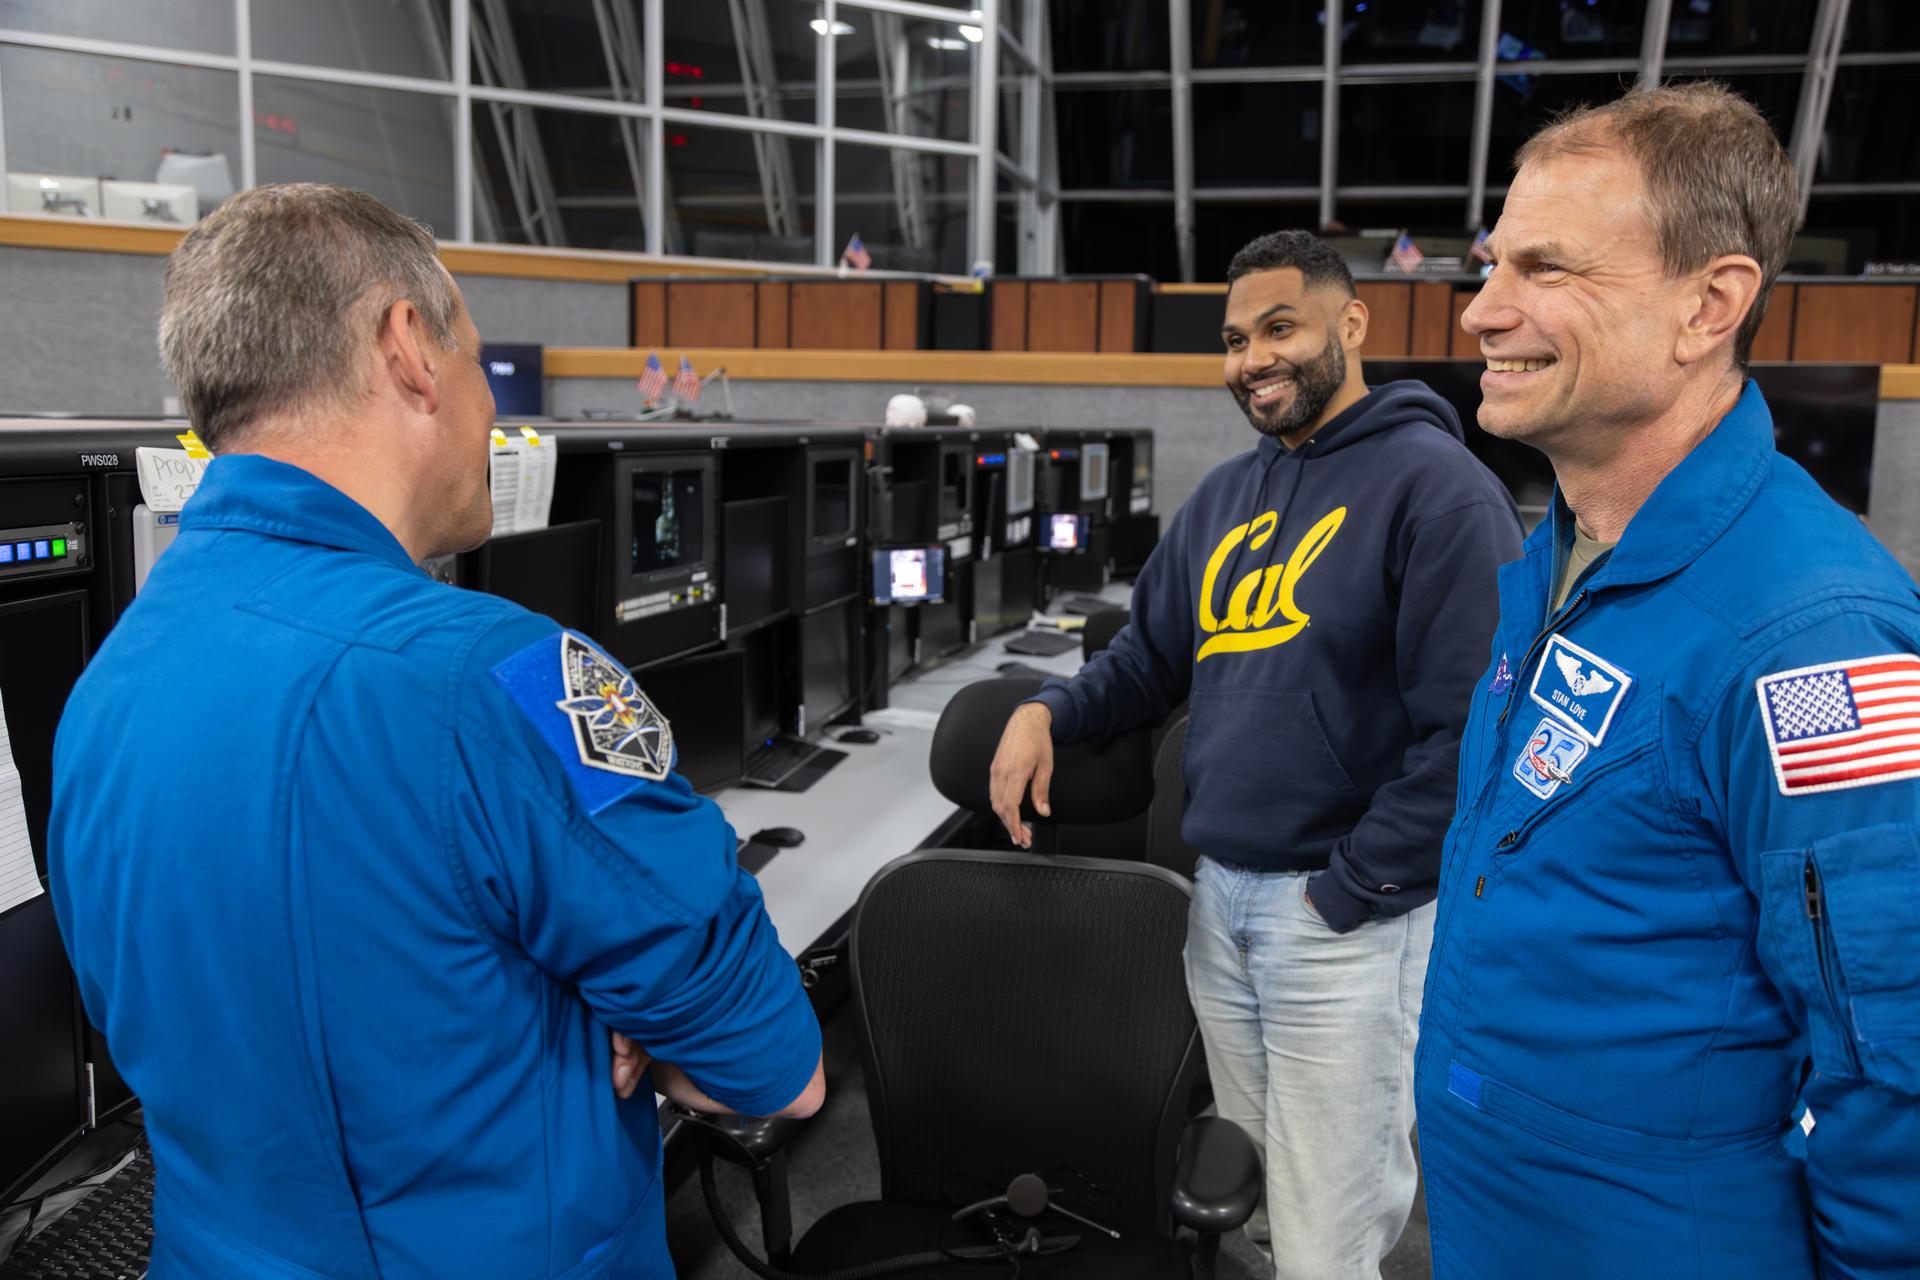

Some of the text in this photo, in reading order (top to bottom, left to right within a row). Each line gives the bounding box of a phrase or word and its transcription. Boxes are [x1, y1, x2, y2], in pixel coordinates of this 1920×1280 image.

[81, 454, 119, 467] PWS028
[1197, 506, 1347, 662] Cal
[1552, 689, 1588, 721] STAN LOVE
